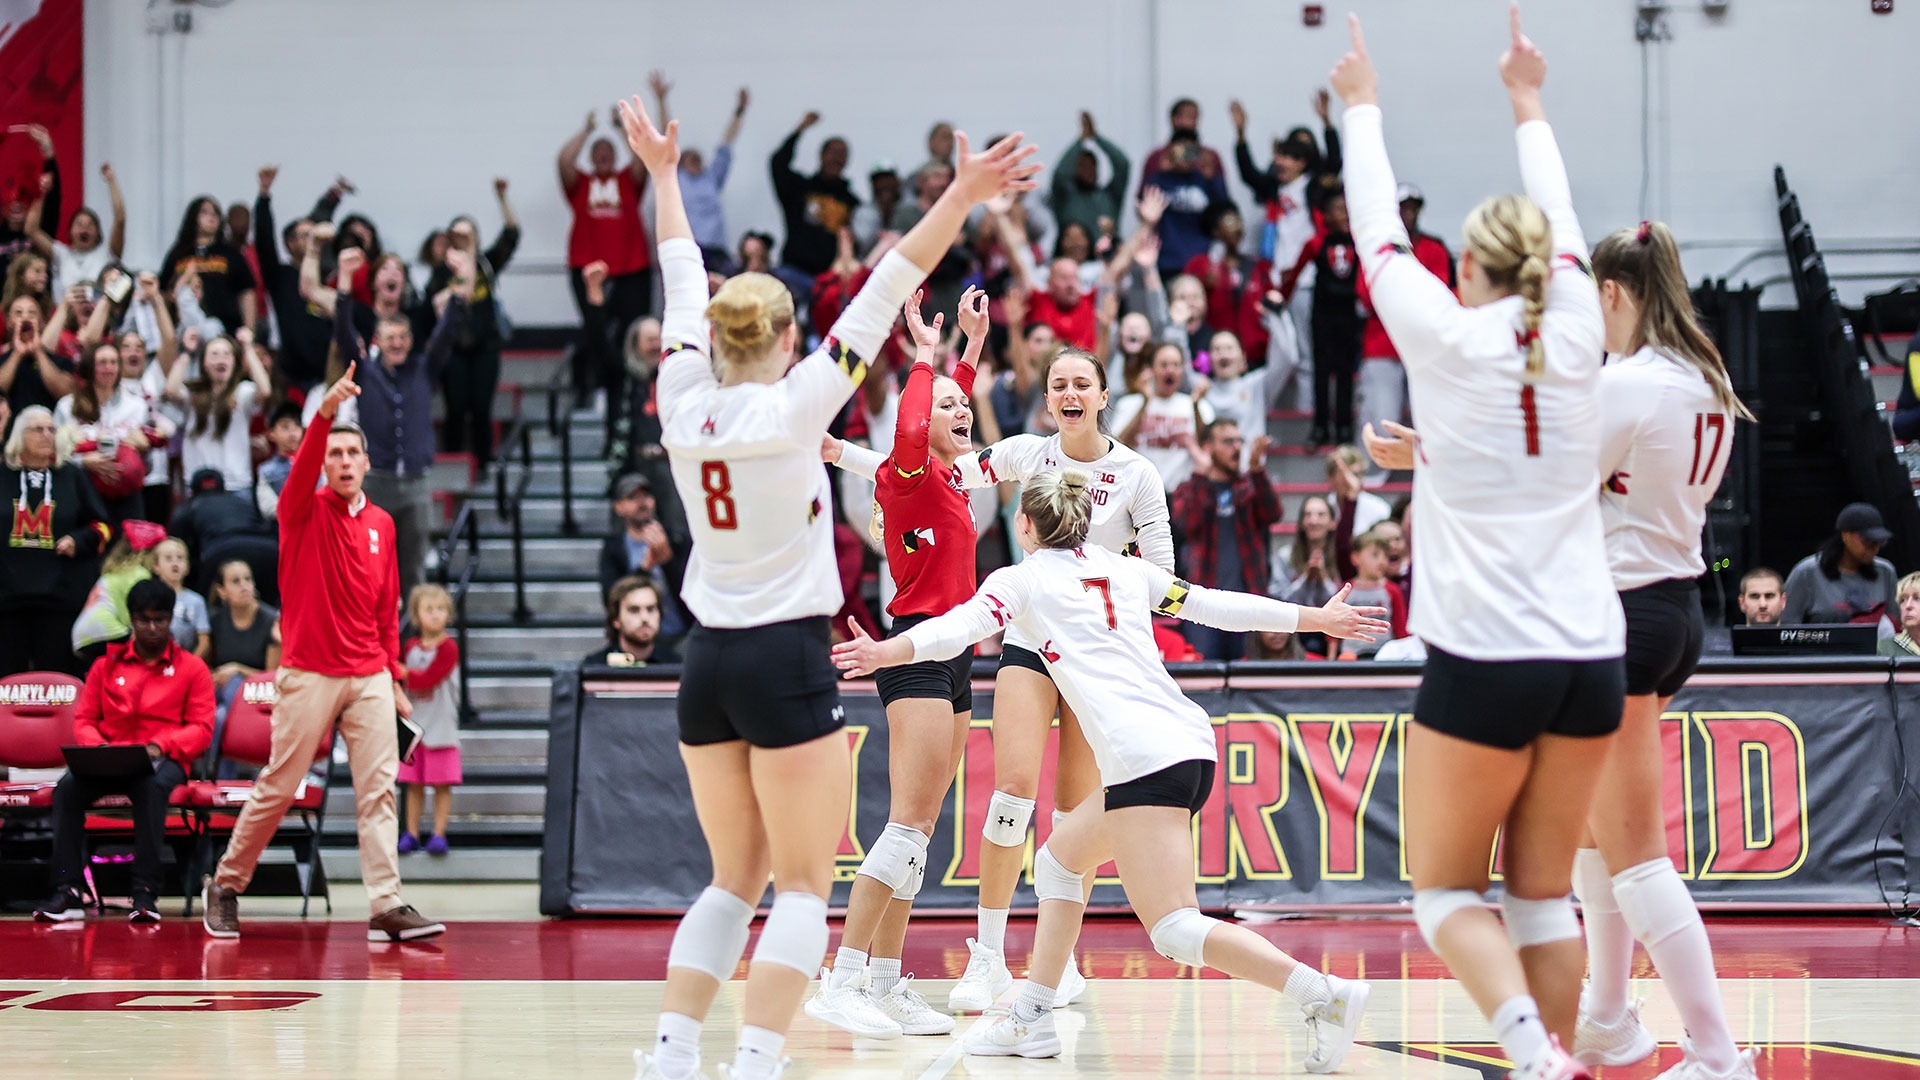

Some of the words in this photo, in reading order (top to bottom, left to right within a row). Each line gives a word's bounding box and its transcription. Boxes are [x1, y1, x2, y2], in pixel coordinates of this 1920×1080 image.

[1520, 384, 1541, 457] 1
[1688, 413, 1725, 486] 17
[11, 498, 57, 548] M
[701, 460, 738, 530] 8
[1090, 487, 1109, 506] ND
[1080, 576, 1118, 631] 7
